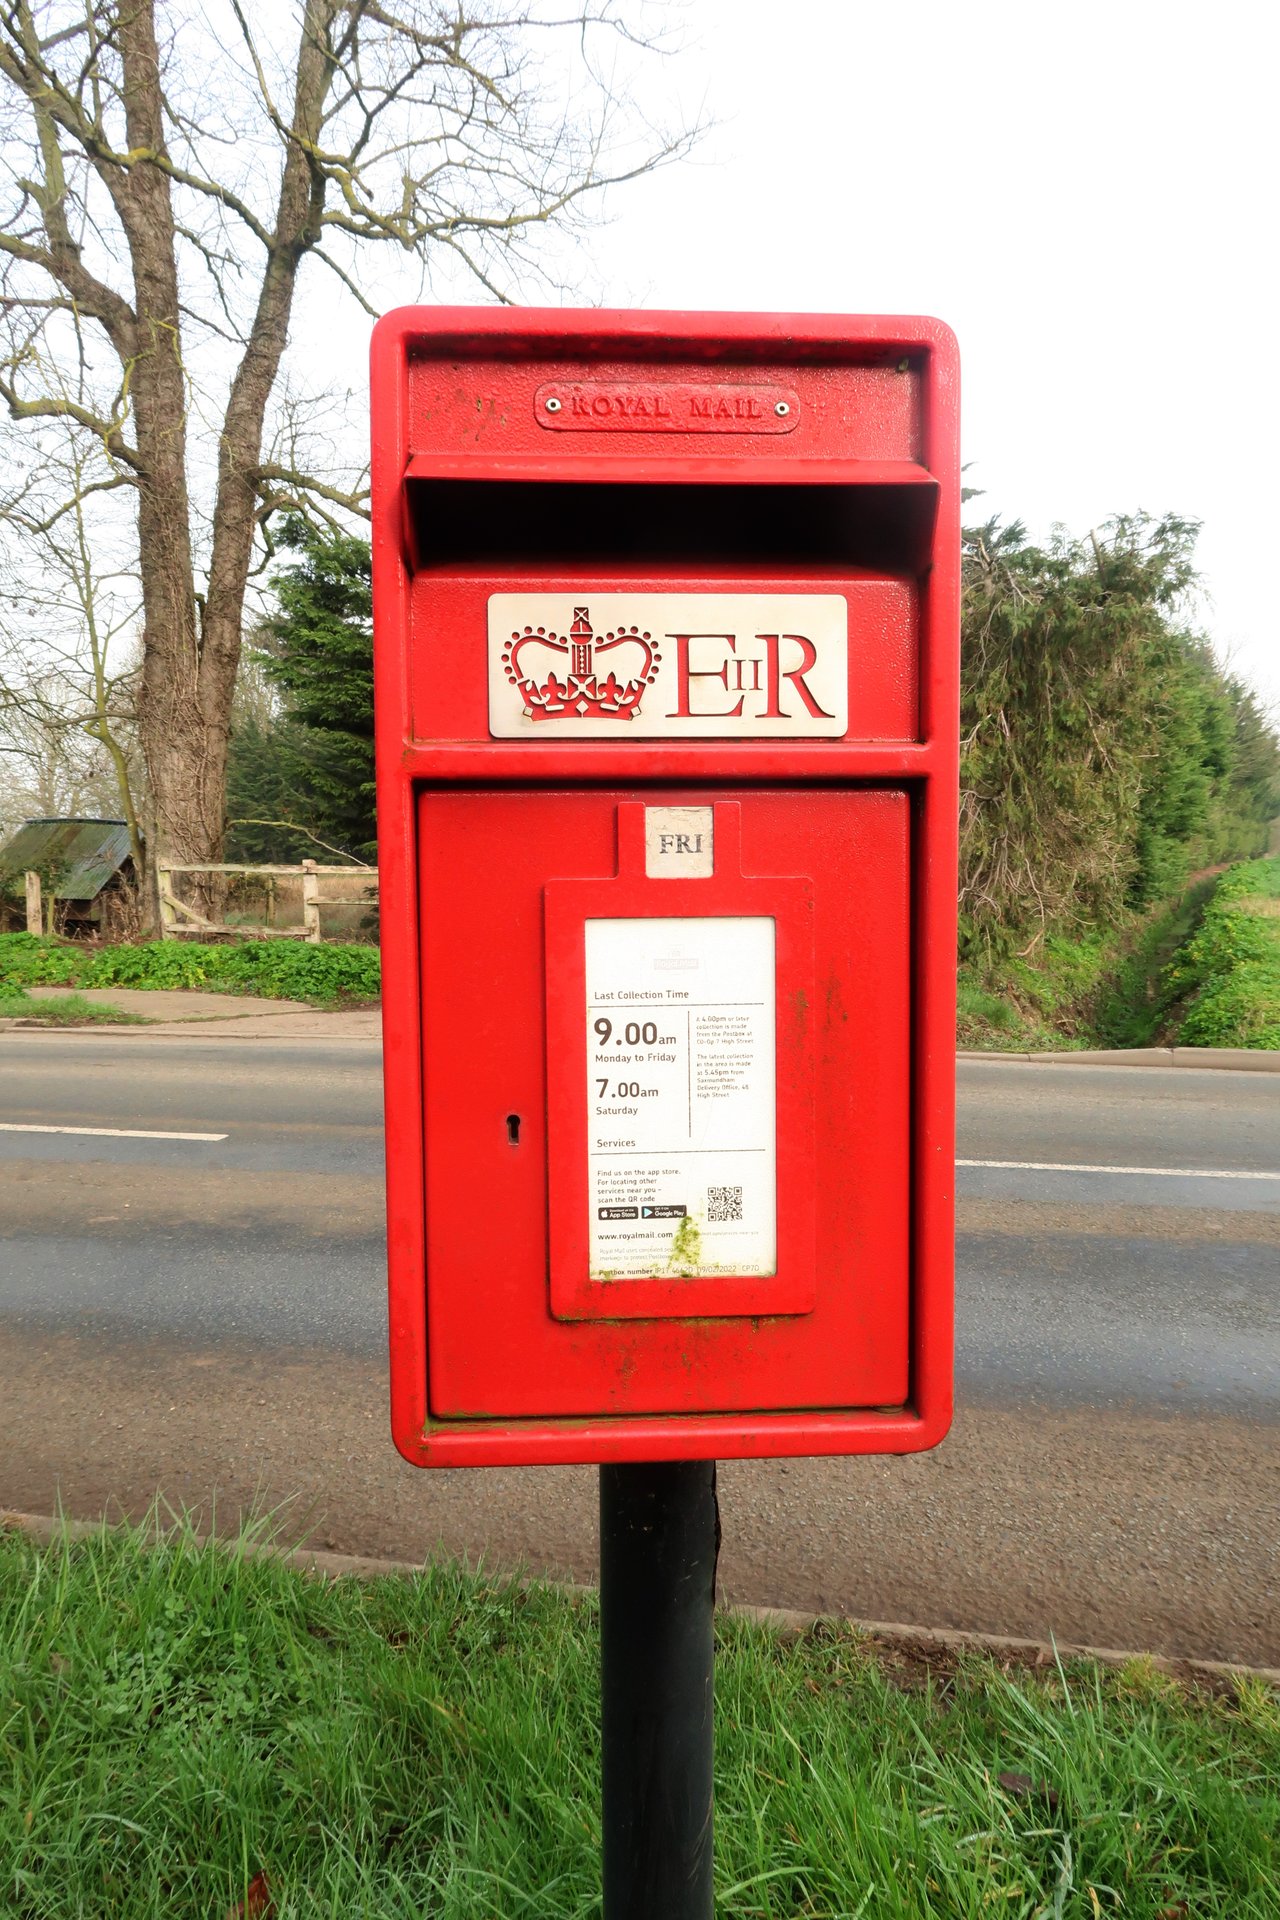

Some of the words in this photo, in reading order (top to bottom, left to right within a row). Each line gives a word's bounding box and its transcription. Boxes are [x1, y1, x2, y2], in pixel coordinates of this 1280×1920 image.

[572, 396, 670, 416] ROYAL
[692, 397, 763, 417] MAIL
[659, 834, 703, 853] FRI
[594, 991, 614, 1000] Last
[618, 990, 663, 1000] Collection
[666, 989, 689, 999] Time
[594, 1017, 676, 1046] 9.00am
[595, 1055, 632, 1063] Monday
[635, 1054, 644, 1062] to
[648, 1052, 676, 1062] Friday
[596, 1078, 659, 1098] 7.00am
[596, 1106, 638, 1116] Saturday
[597, 1138, 636, 1147] Services
[610, 1178, 637, 1187] locating
[598, 1231, 673, 1241] www.royalmail.com
